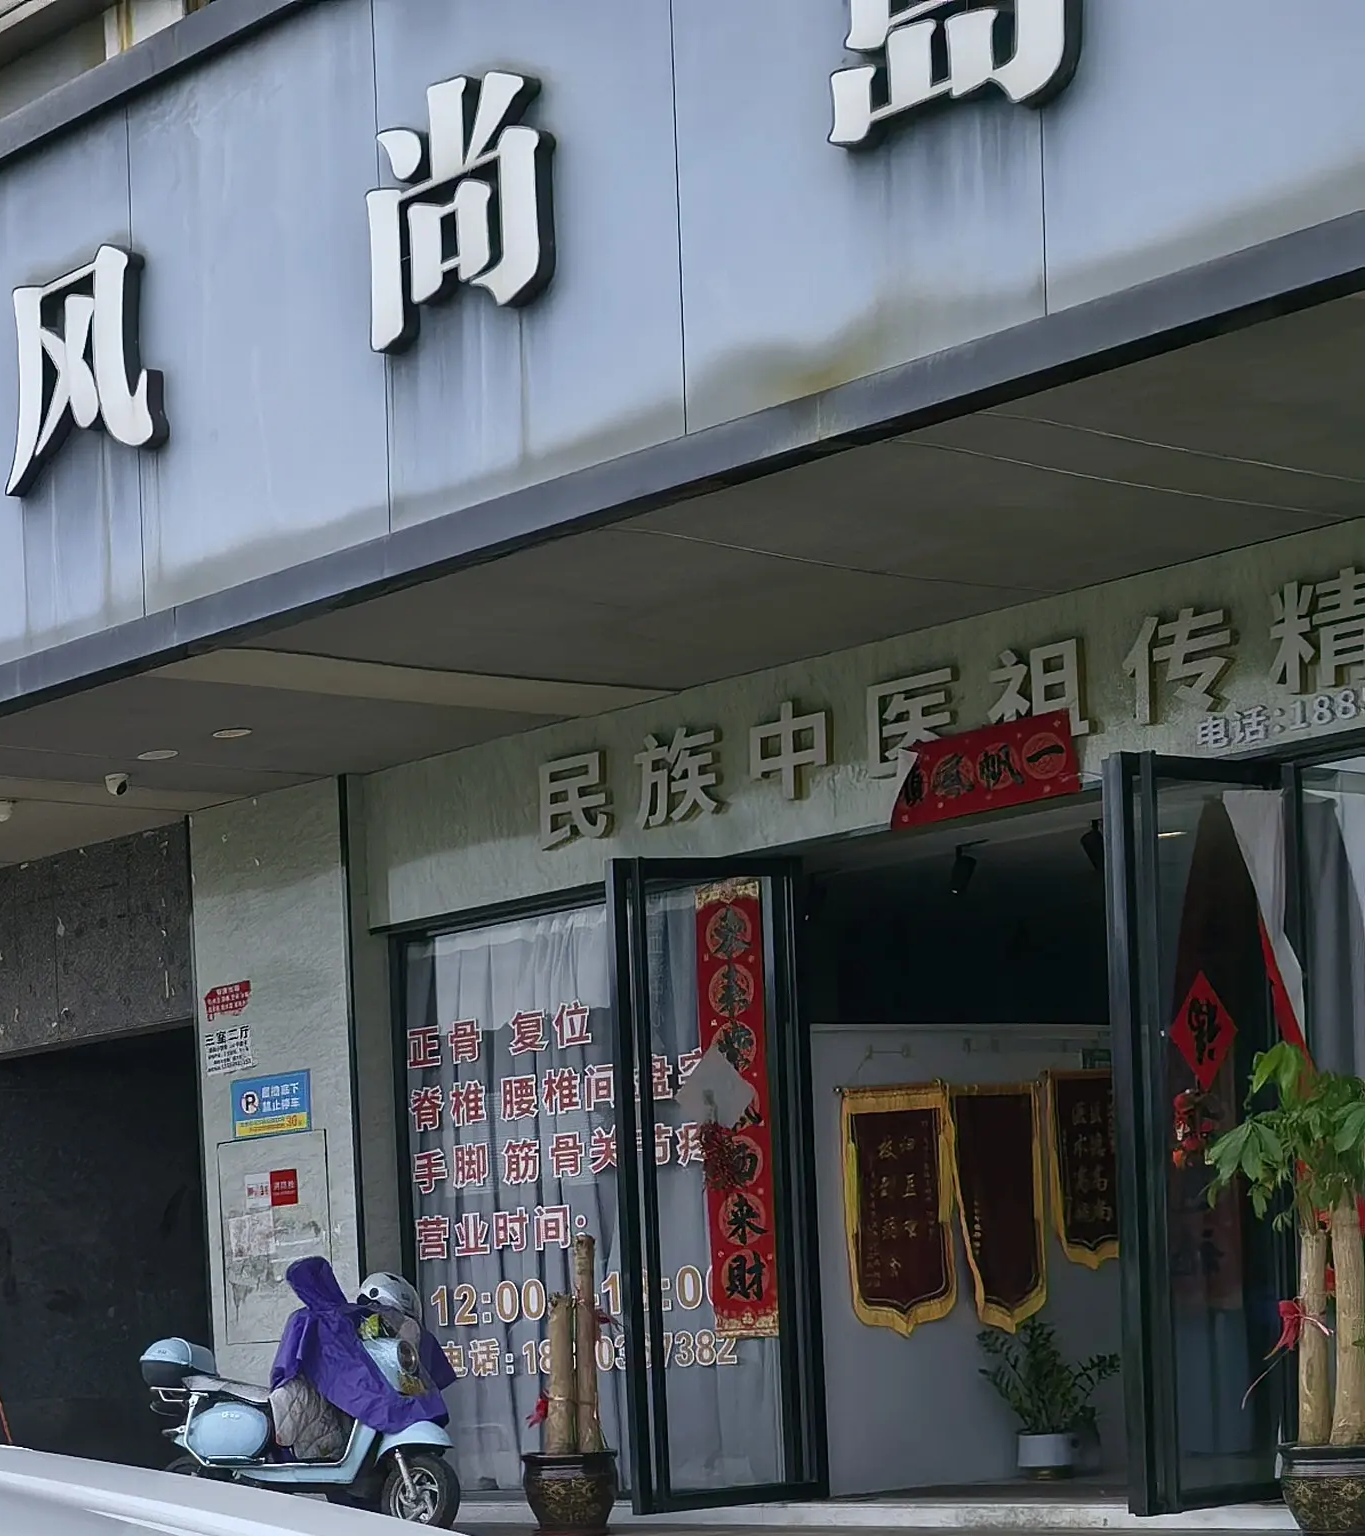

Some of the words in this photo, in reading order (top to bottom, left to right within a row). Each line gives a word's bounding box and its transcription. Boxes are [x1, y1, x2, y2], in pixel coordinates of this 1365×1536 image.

[538, 567, 1365, 850] 民族中医祖传精
[1197, 687, 1365, 750] 电话:188
[407, 1018, 483, 1070] 正骨
[509, 999, 592, 1056] 复位
[409, 1081, 486, 1132] 脊椎
[412, 1139, 489, 1195] 手脚
